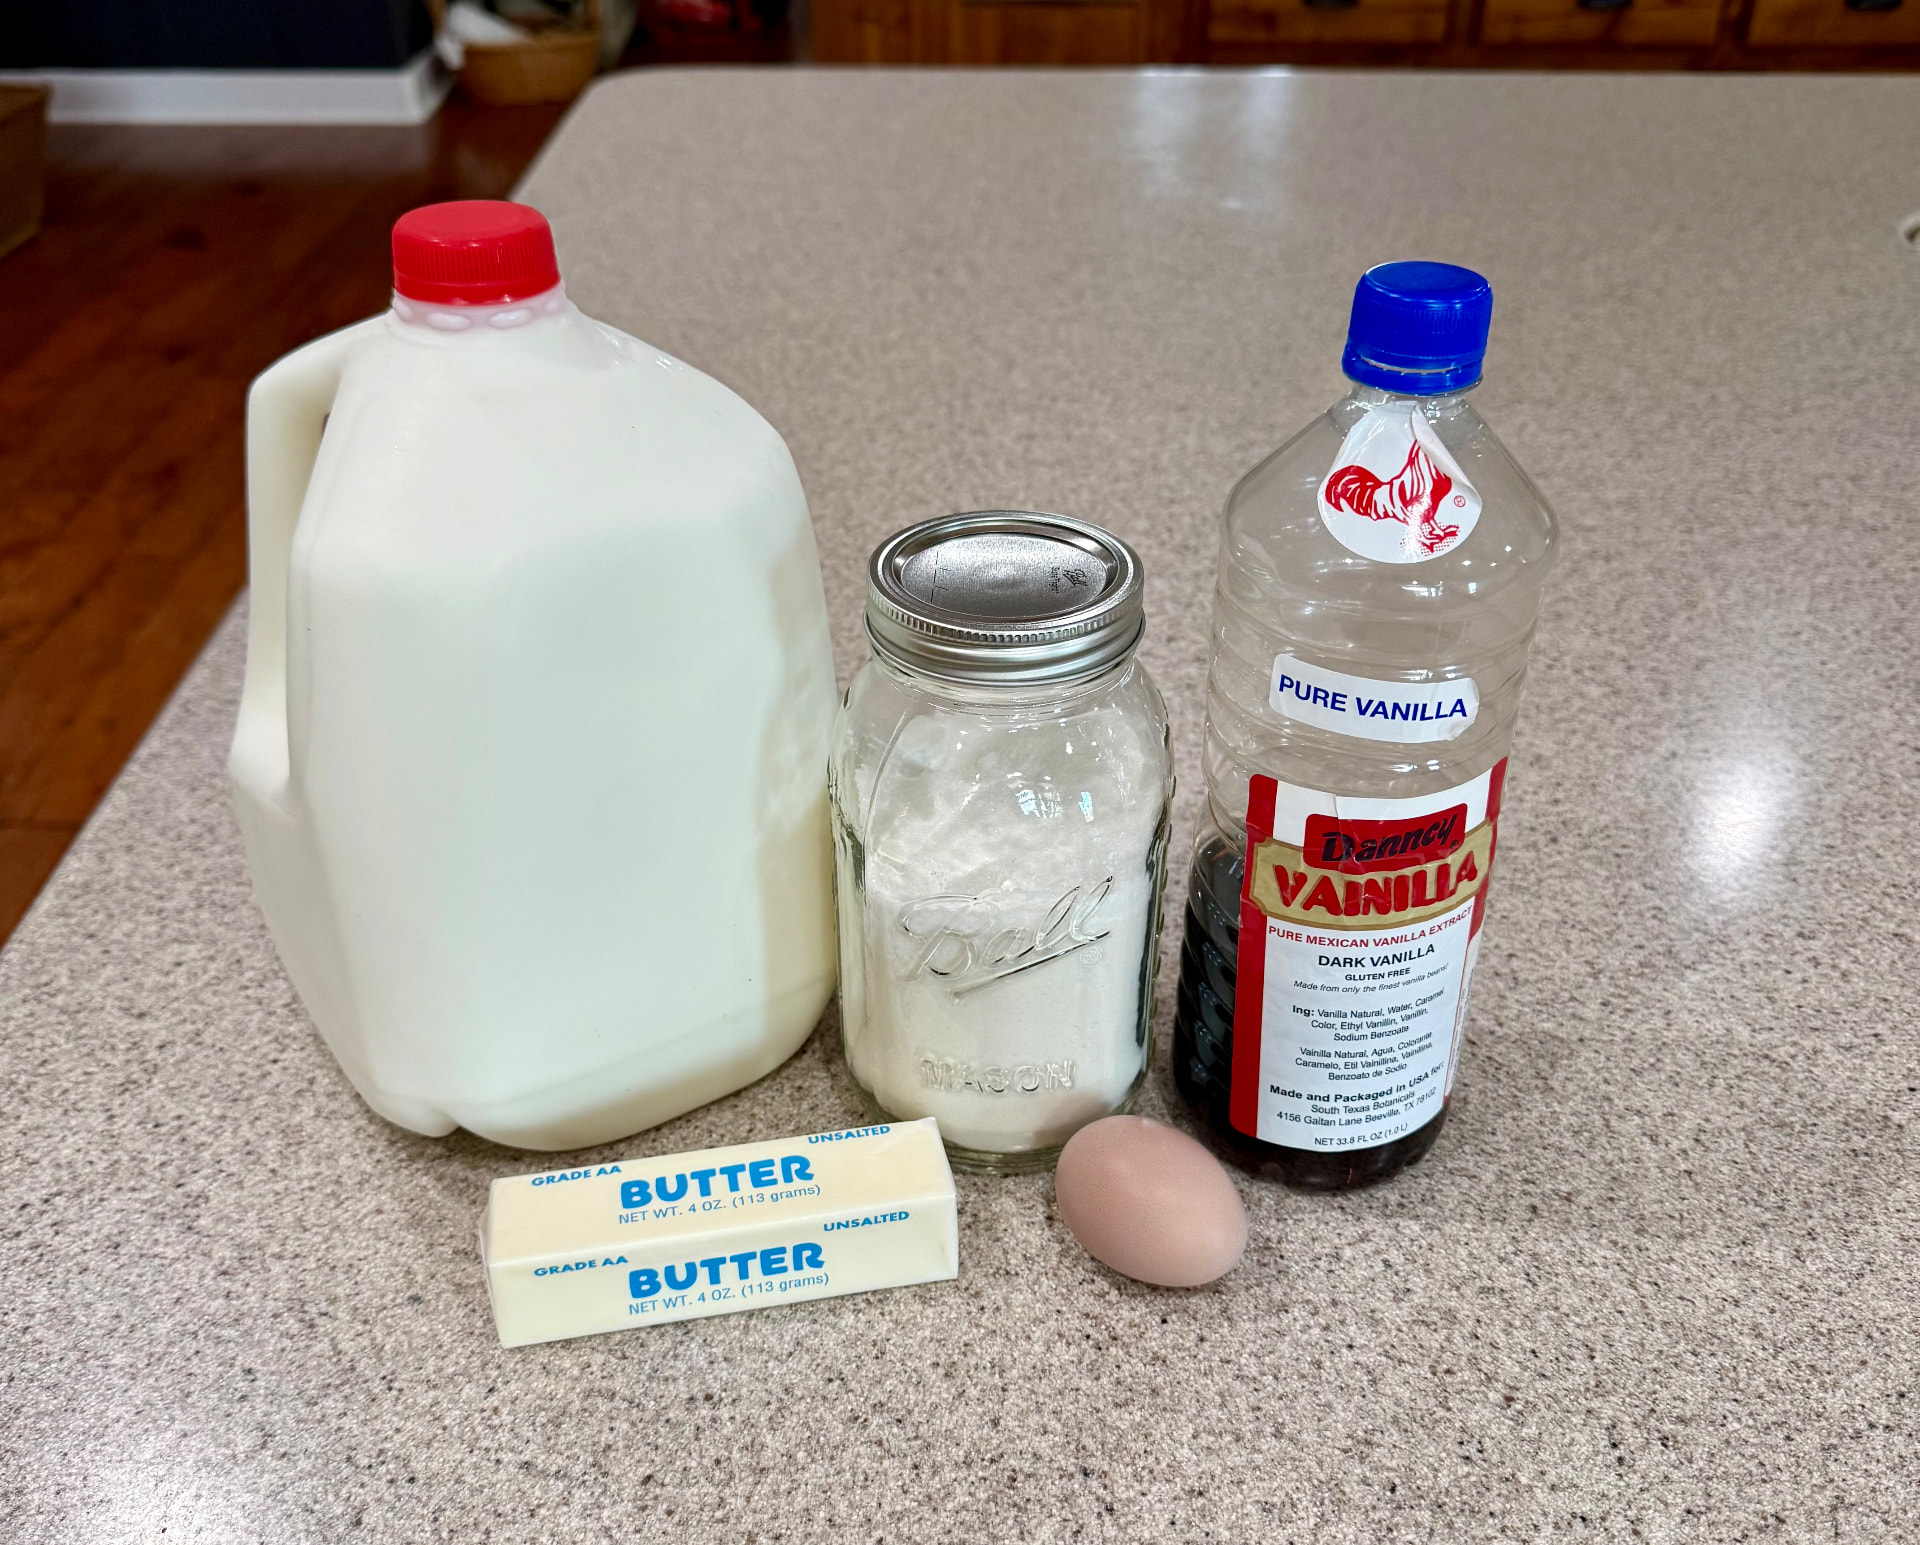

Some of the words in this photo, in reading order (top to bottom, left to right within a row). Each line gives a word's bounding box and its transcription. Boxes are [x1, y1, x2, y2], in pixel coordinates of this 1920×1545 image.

[1278, 674, 1348, 712] PURE
[1356, 698, 1468, 721] VANILLA
[1322, 813, 1458, 862] Danncy
[1273, 851, 1478, 916] VAINILLA
[898, 875, 1112, 990] Ball
[1268, 925, 1303, 942] PURE
[1306, 935, 1369, 948] MEXICAN
[1372, 929, 1427, 947] VANILLA
[1429, 905, 1473, 936] EXTRACT
[1318, 955, 1366, 968] DARK
[1370, 943, 1435, 967] VANILLA
[1293, 980, 1318, 991] Made
[1319, 983, 1340, 993] from
[1341, 986, 1361, 995] only
[1362, 985, 1377, 993] the
[1378, 982, 1400, 992] finest
[1401, 974, 1425, 987] vanilla
[1345, 973, 1385, 981] GLUTEN
[1387, 967, 1411, 978] FREE
[1292, 1004, 1315, 1017] Ing:
[1317, 1009, 1348, 1019] Vanilla
[1350, 1009, 1384, 1019] Natural,
[1387, 1003, 1413, 1015] Water,
[1415, 987, 1445, 1007] Caramel
[1311, 1019, 1337, 1031] Color,
[1340, 1021, 1363, 1032] Ethyl
[1365, 1017, 1398, 1029] Vanillin,
[1333, 1032, 1368, 1042] Sodium
[1370, 1024, 1409, 1040] Benzoate
[1295, 1058, 1341, 1071] Caramelo,
[1343, 1061, 1359, 1070] Etil
[1360, 1056, 1399, 1069] Vainillina,
[1299, 1047, 1332, 1058] Vainilla
[1334, 1049, 1369, 1059] Natural,
[1371, 1046, 1396, 1058] Agua,
[920, 1057, 1076, 1093] MASON
[1328, 1072, 1370, 1081] Benzoato
[1371, 1069, 1383, 1078] de
[1384, 1062, 1407, 1076] Sodio
[1269, 1084, 1303, 1099] Made
[1306, 1093, 1330, 1103] and
[1334, 1088, 1393, 1104] Packaged
[1395, 1082, 1406, 1093] in
[1408, 1071, 1429, 1087] USA
[1276, 1111, 1301, 1123] 4156
[1338, 1116, 1363, 1126] Lane
[1364, 1107, 1401, 1123] Beeville,
[1403, 1101, 1415, 1112] TX
[1414, 1086, 1437, 1108] 78102
[1311, 1104, 1340, 1115] South
[1343, 1105, 1370, 1114] Texas
[1372, 1090, 1416, 1110] Botanicals
[808, 1125, 891, 1144] UNSALTED
[1314, 1136, 1334, 1146] NET
[1336, 1136, 1355, 1146] 33.8
[1357, 1135, 1369, 1143] FL
[1370, 1131, 1383, 1141] OZ
[1399, 1122, 1408, 1133] L)
[531, 1166, 593, 1187] GRADE
[596, 1164, 622, 1177] AA
[620, 1154, 815, 1210] BUTTER
[618, 1210, 649, 1225] NET
[653, 1205, 684, 1220] WT.
[687, 1202, 697, 1214] 4
[701, 1198, 728, 1212] OZ.
[732, 1190, 766, 1210] (113
[769, 1184, 822, 1206] grams)
[823, 1211, 910, 1233] UNSALTED
[533, 1257, 598, 1277] GRADE
[602, 1255, 629, 1268] AA
[628, 1241, 826, 1300] BUTTER
[628, 1301, 660, 1316] NET
[663, 1296, 693, 1311] WT.
[697, 1292, 707, 1304] 4
[711, 1287, 736, 1302] OZ.
[741, 1279, 775, 1300] (113
[779, 1272, 830, 1295] grams)
